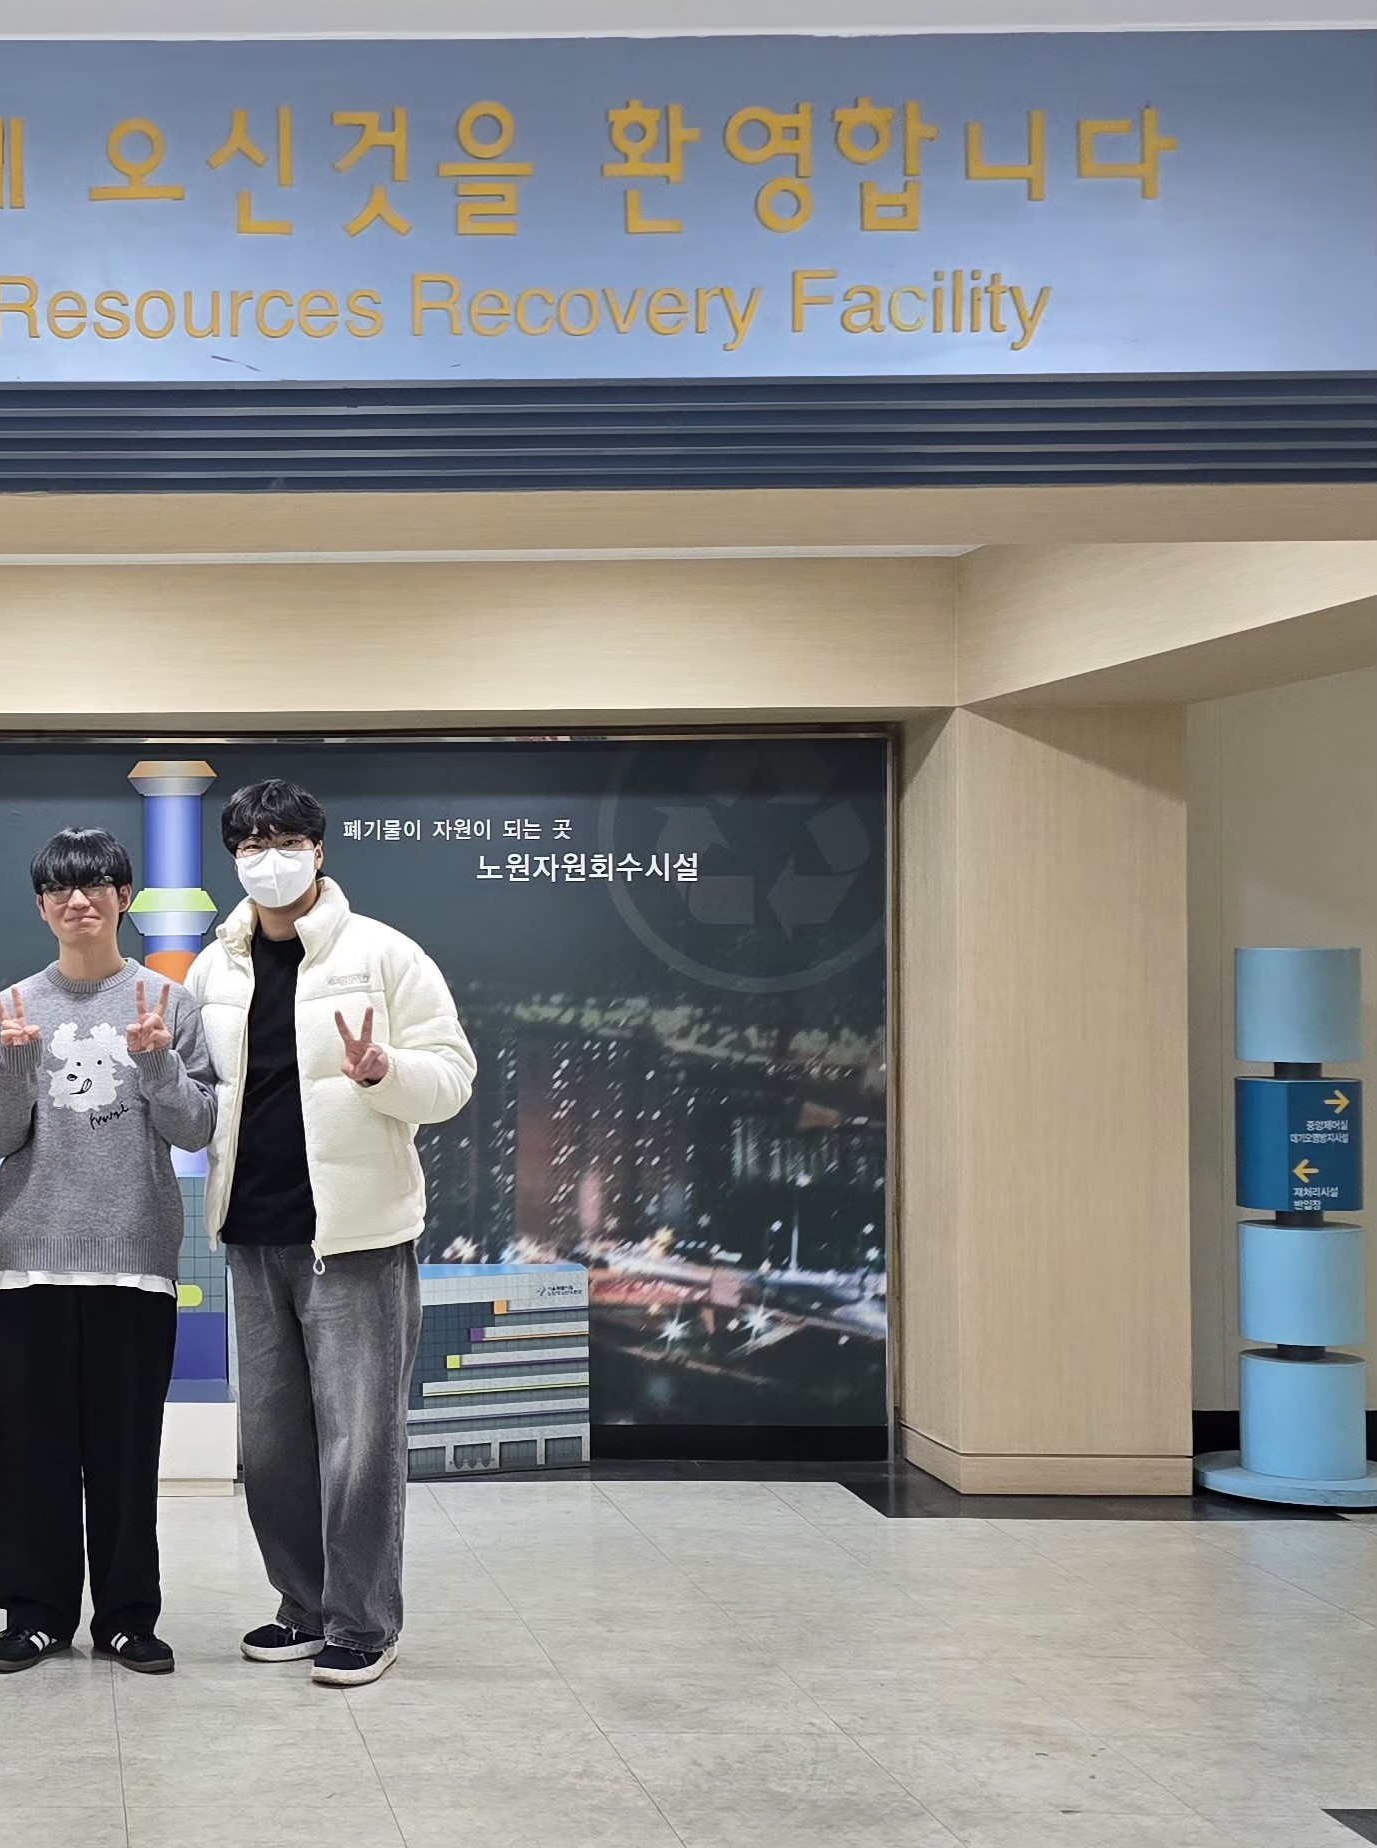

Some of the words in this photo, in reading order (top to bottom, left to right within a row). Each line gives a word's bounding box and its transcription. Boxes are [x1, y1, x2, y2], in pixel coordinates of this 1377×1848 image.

[89, 102, 533, 236] 오신것을
[602, 97, 1179, 235] 환영합니다
[411, 273, 759, 351] Recovery
[792, 270, 1050, 350] Facility
[342, 819, 421, 841] 폐기물이
[432, 818, 492, 841] 자원이
[502, 819, 542, 840] 되는
[551, 819, 573, 841] 곳
[476, 852, 700, 883] 노원자원회수시설
